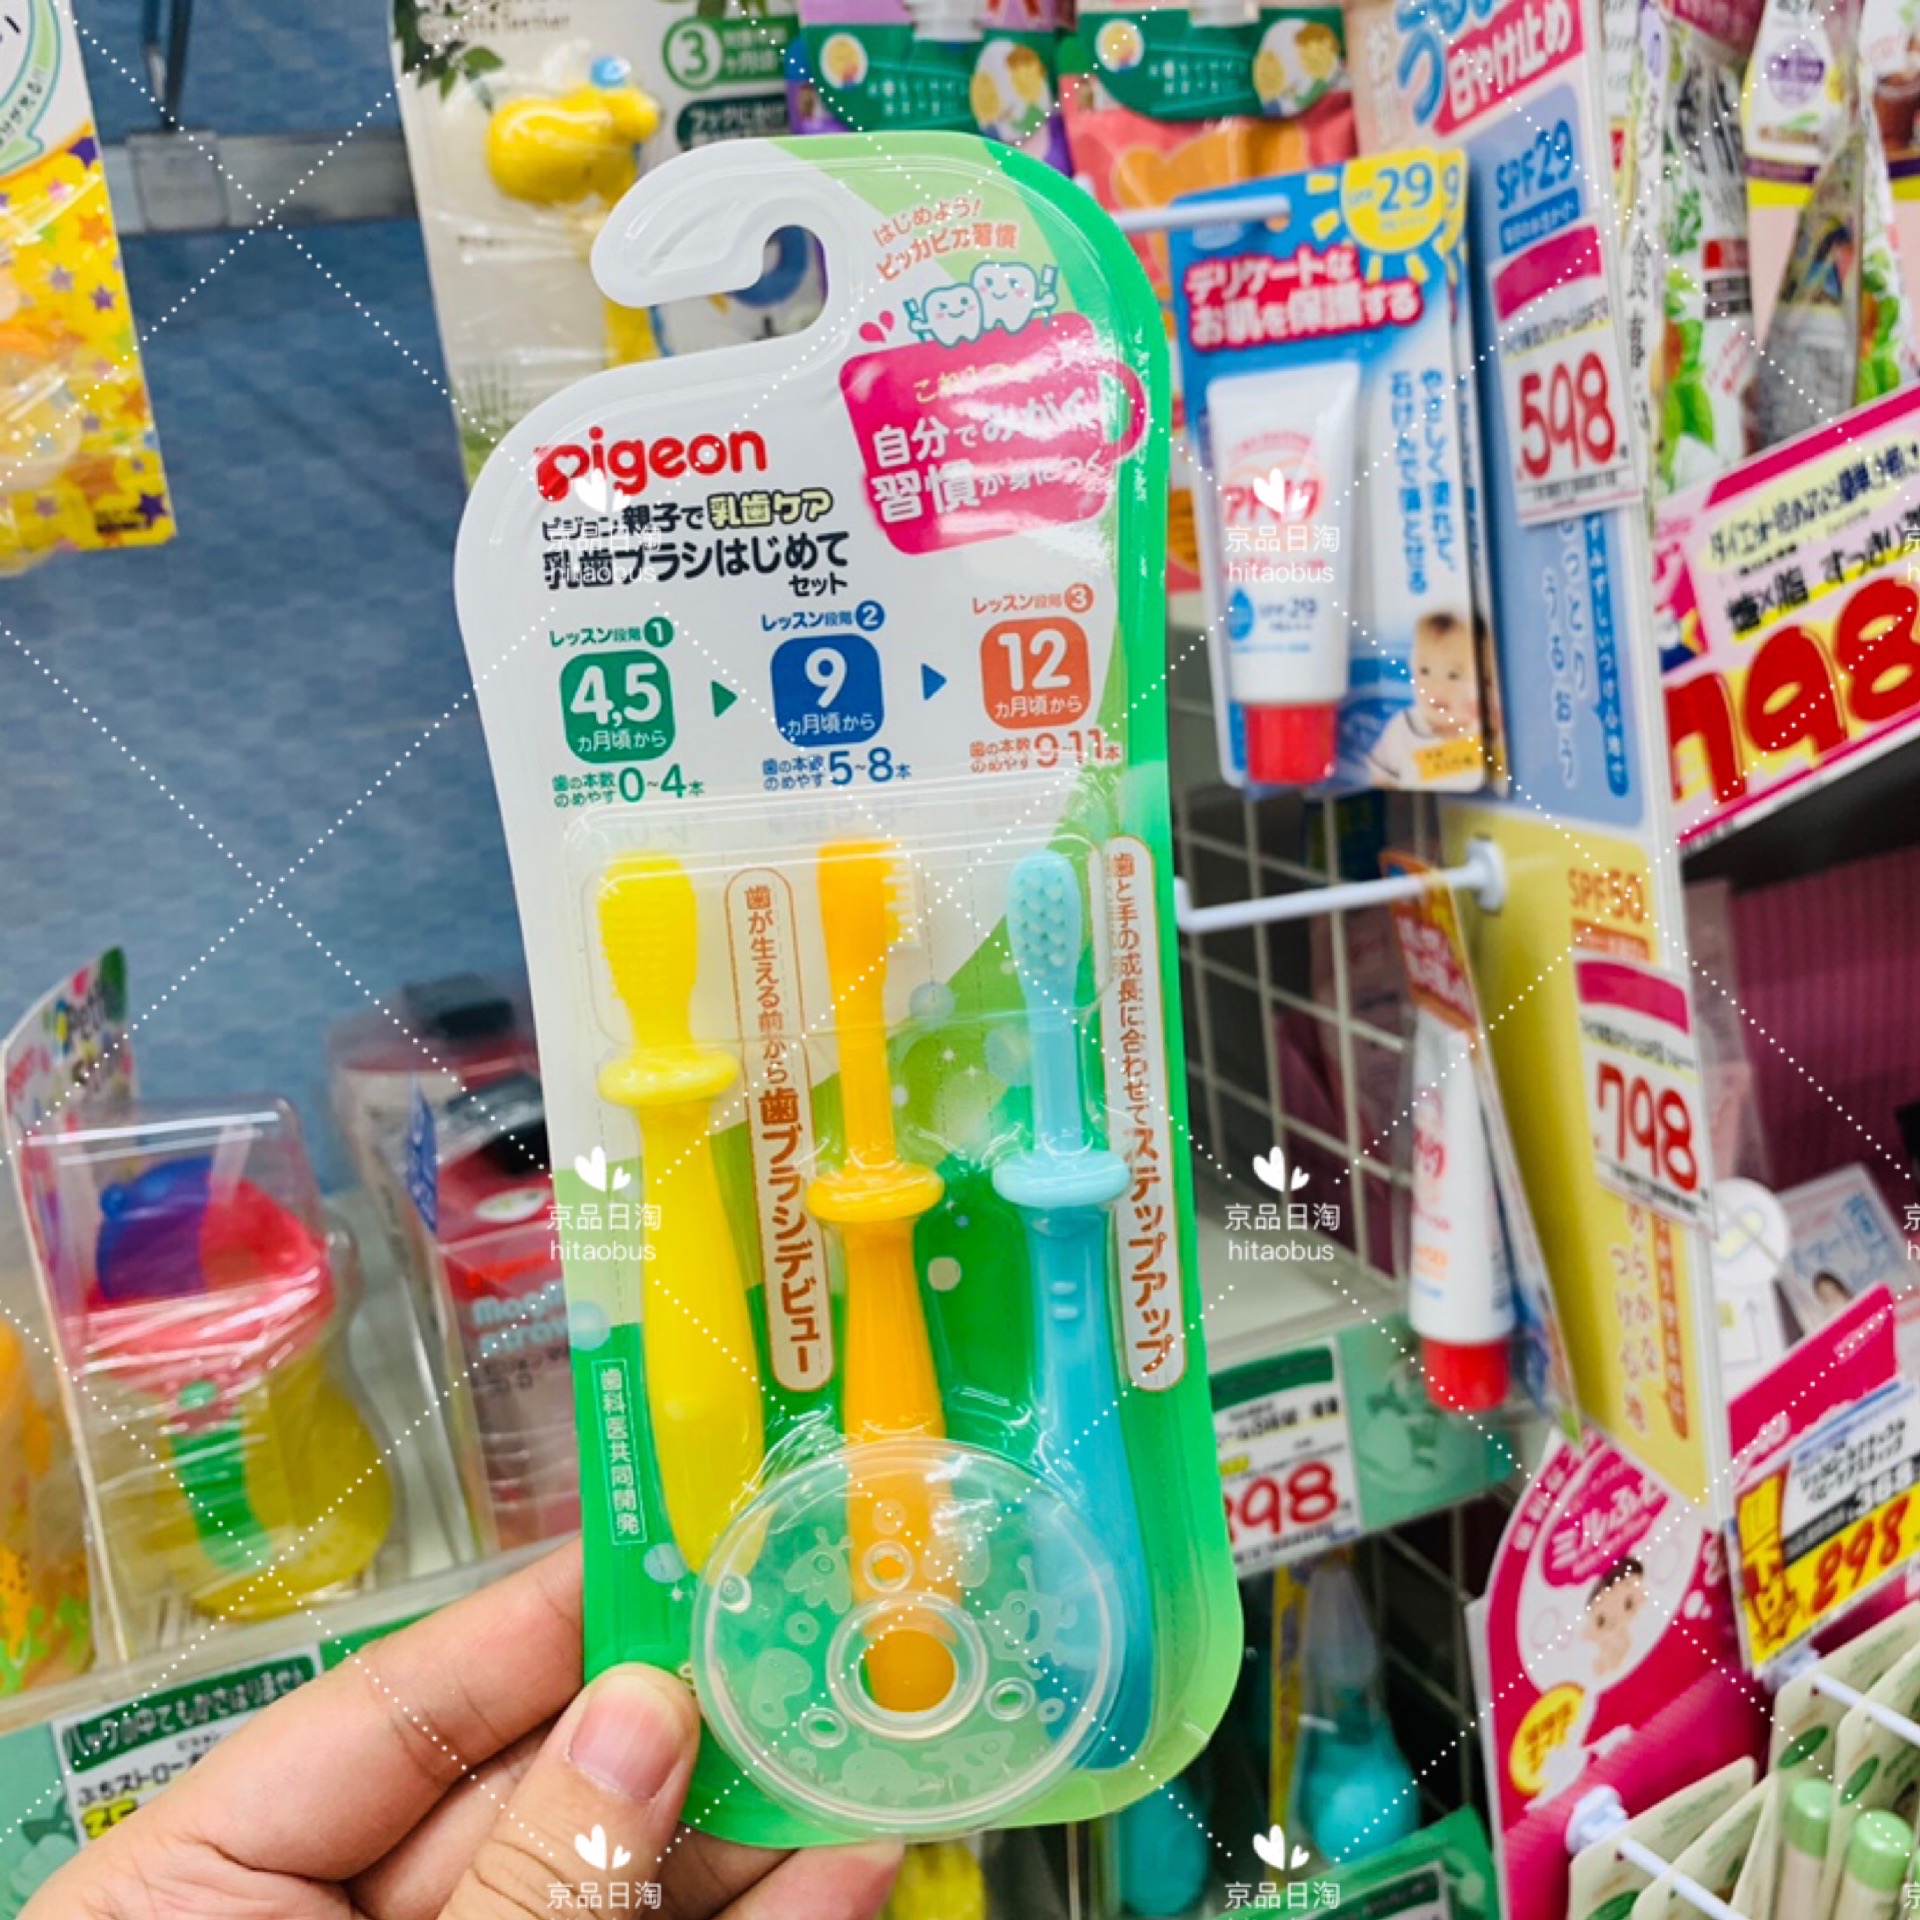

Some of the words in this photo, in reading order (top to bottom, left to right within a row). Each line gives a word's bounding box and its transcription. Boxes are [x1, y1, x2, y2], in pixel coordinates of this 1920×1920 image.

[1376, 161, 1435, 212] 29
[1519, 350, 1616, 480] 598
[542, 531, 849, 591] 乳歯ブラシはじめて
[788, 575, 848, 598] セット
[804, 647, 848, 708] 9
[997, 628, 1071, 692] 12
